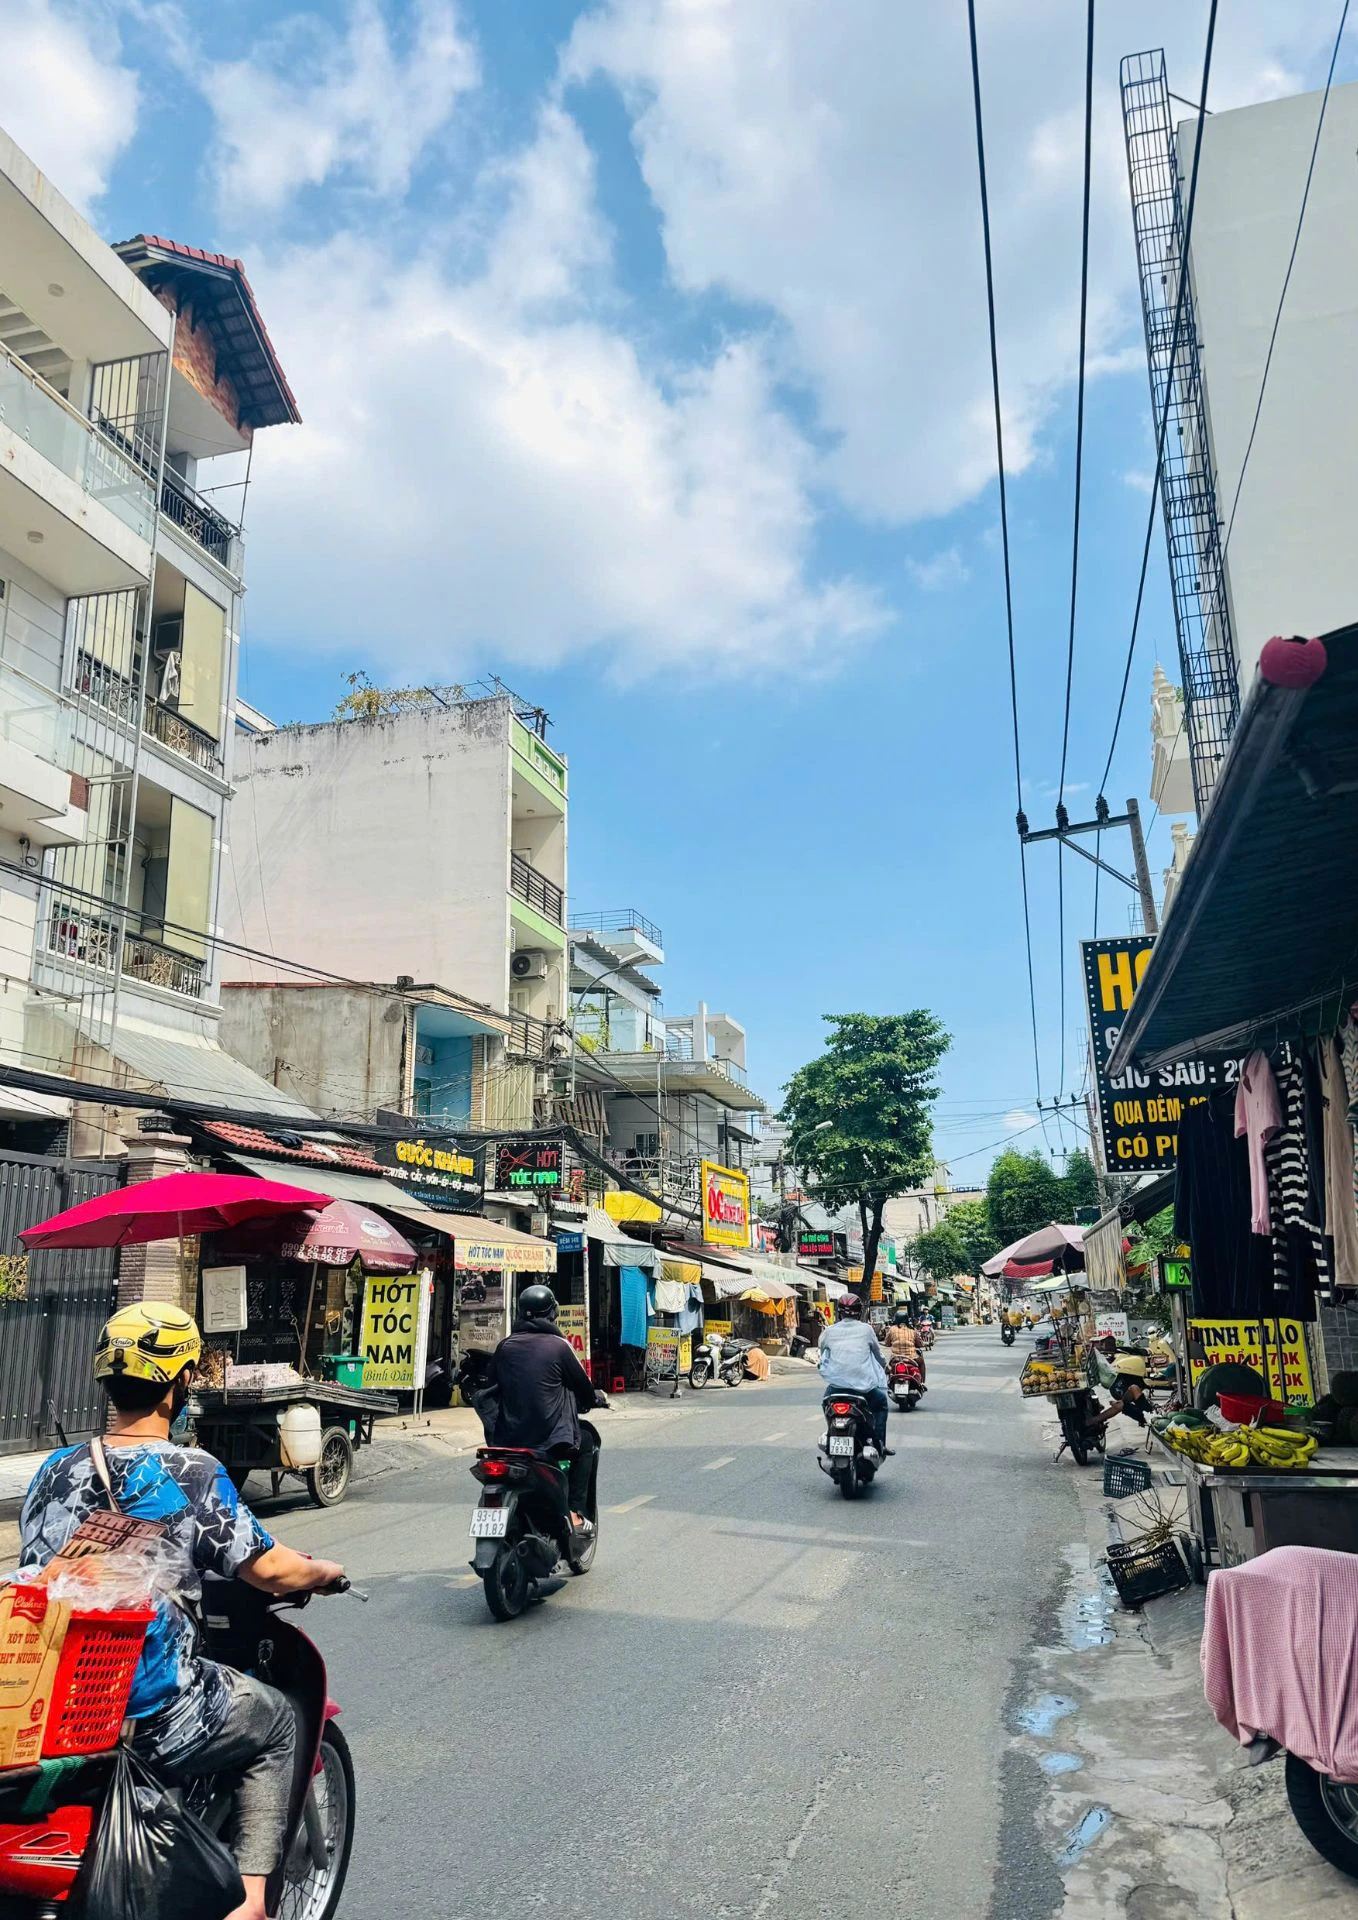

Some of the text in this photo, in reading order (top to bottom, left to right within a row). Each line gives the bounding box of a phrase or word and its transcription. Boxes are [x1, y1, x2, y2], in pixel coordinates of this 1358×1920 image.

[1114, 1101, 1145, 1127] QUA
[396, 1140, 433, 1167] QUỐC
[537, 1146, 559, 1168] HỚT
[1116, 1132, 1149, 1158] CÓ
[510, 1168, 532, 1184] TÓC
[372, 1278, 416, 1303] HỚT
[371, 1307, 412, 1333] TÓC
[366, 1345, 412, 1365] NAM
[471, 1523, 505, 1536] 411.82
